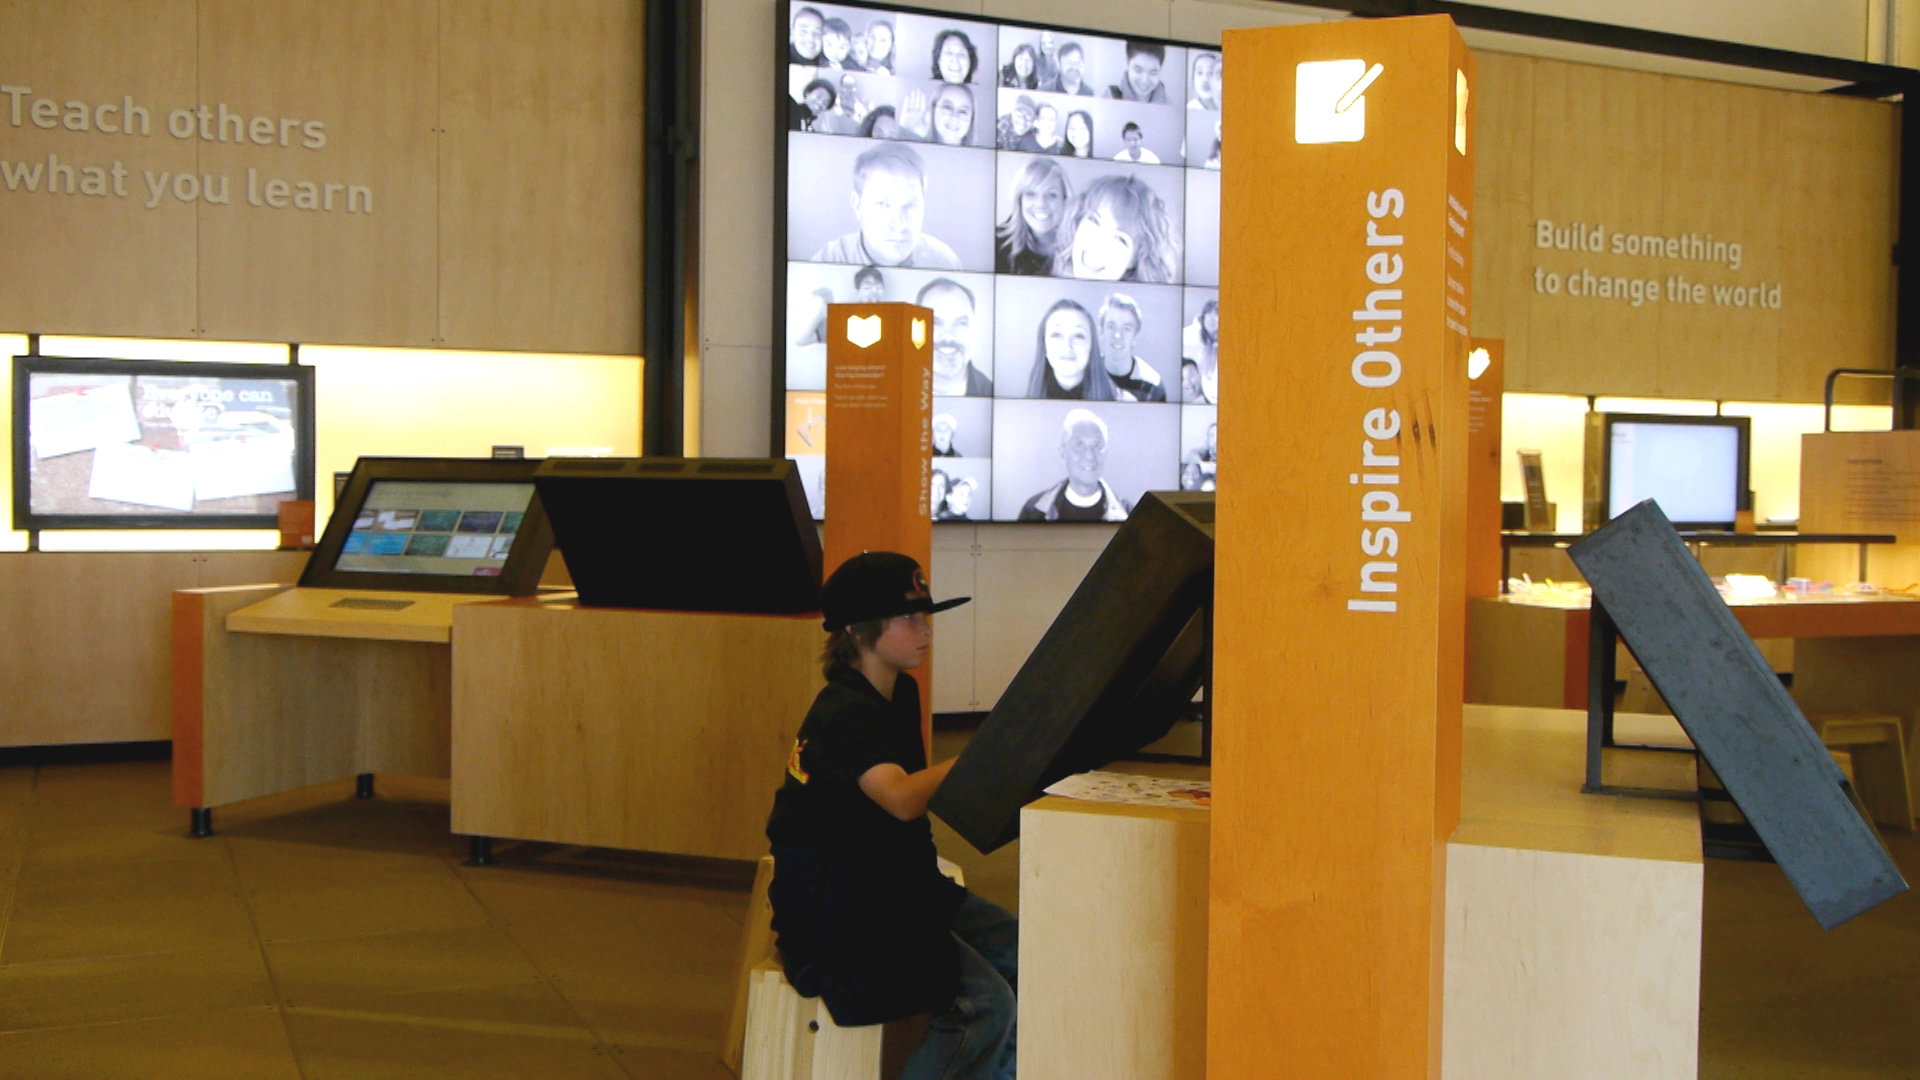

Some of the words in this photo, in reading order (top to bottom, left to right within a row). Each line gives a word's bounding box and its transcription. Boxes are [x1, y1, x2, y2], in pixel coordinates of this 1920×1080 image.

[1, 85, 150, 135] Teach
[168, 102, 327, 149] others
[1, 154, 128, 196] what
[144, 171, 229, 208] you
[247, 167, 373, 213] learn
[1536, 219, 1604, 252] Build
[1611, 231, 1742, 270] something
[1351, 188, 1405, 388] Others
[1534, 267, 1560, 295] to
[1567, 269, 1659, 307] change
[1667, 275, 1706, 304] the
[1713, 281, 1782, 309] world
[238, 389, 273, 403] can
[920, 367, 931, 411] Way
[920, 416, 928, 452] the
[919, 458, 928, 516] Show
[1347, 407, 1412, 612] Inspire
